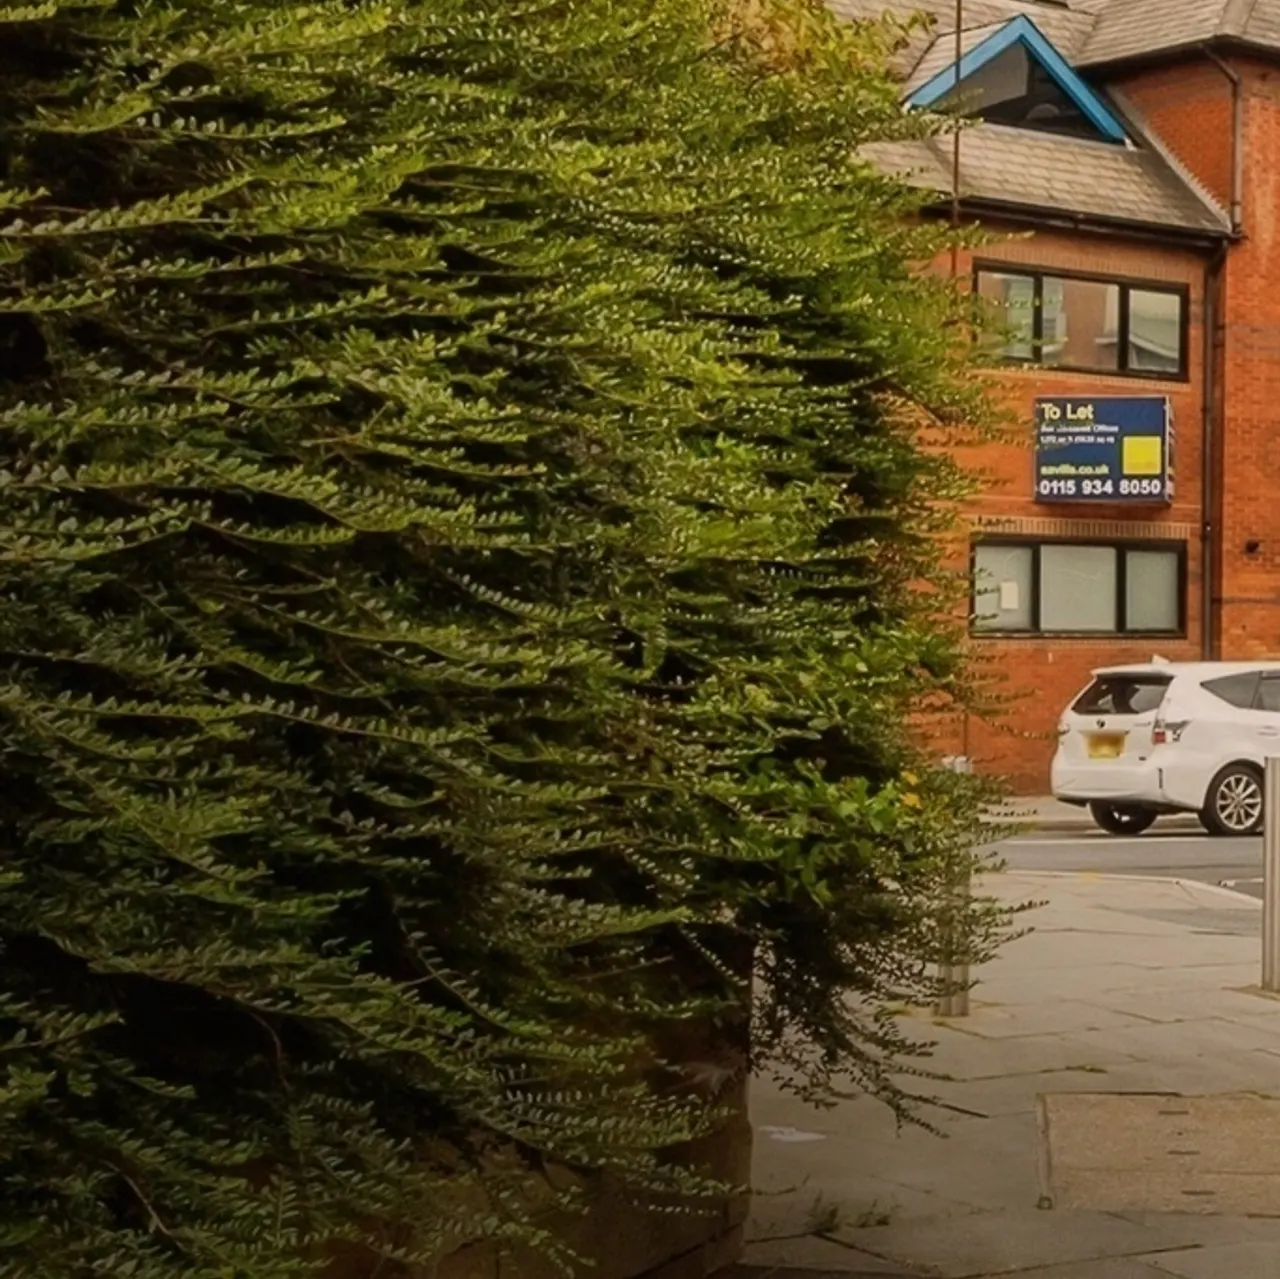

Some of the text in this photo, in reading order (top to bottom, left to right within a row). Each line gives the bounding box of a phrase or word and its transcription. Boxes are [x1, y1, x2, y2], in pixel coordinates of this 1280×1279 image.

[1041, 403, 1094, 419] To Let
[1040, 479, 1161, 495] 0115 934 8050
